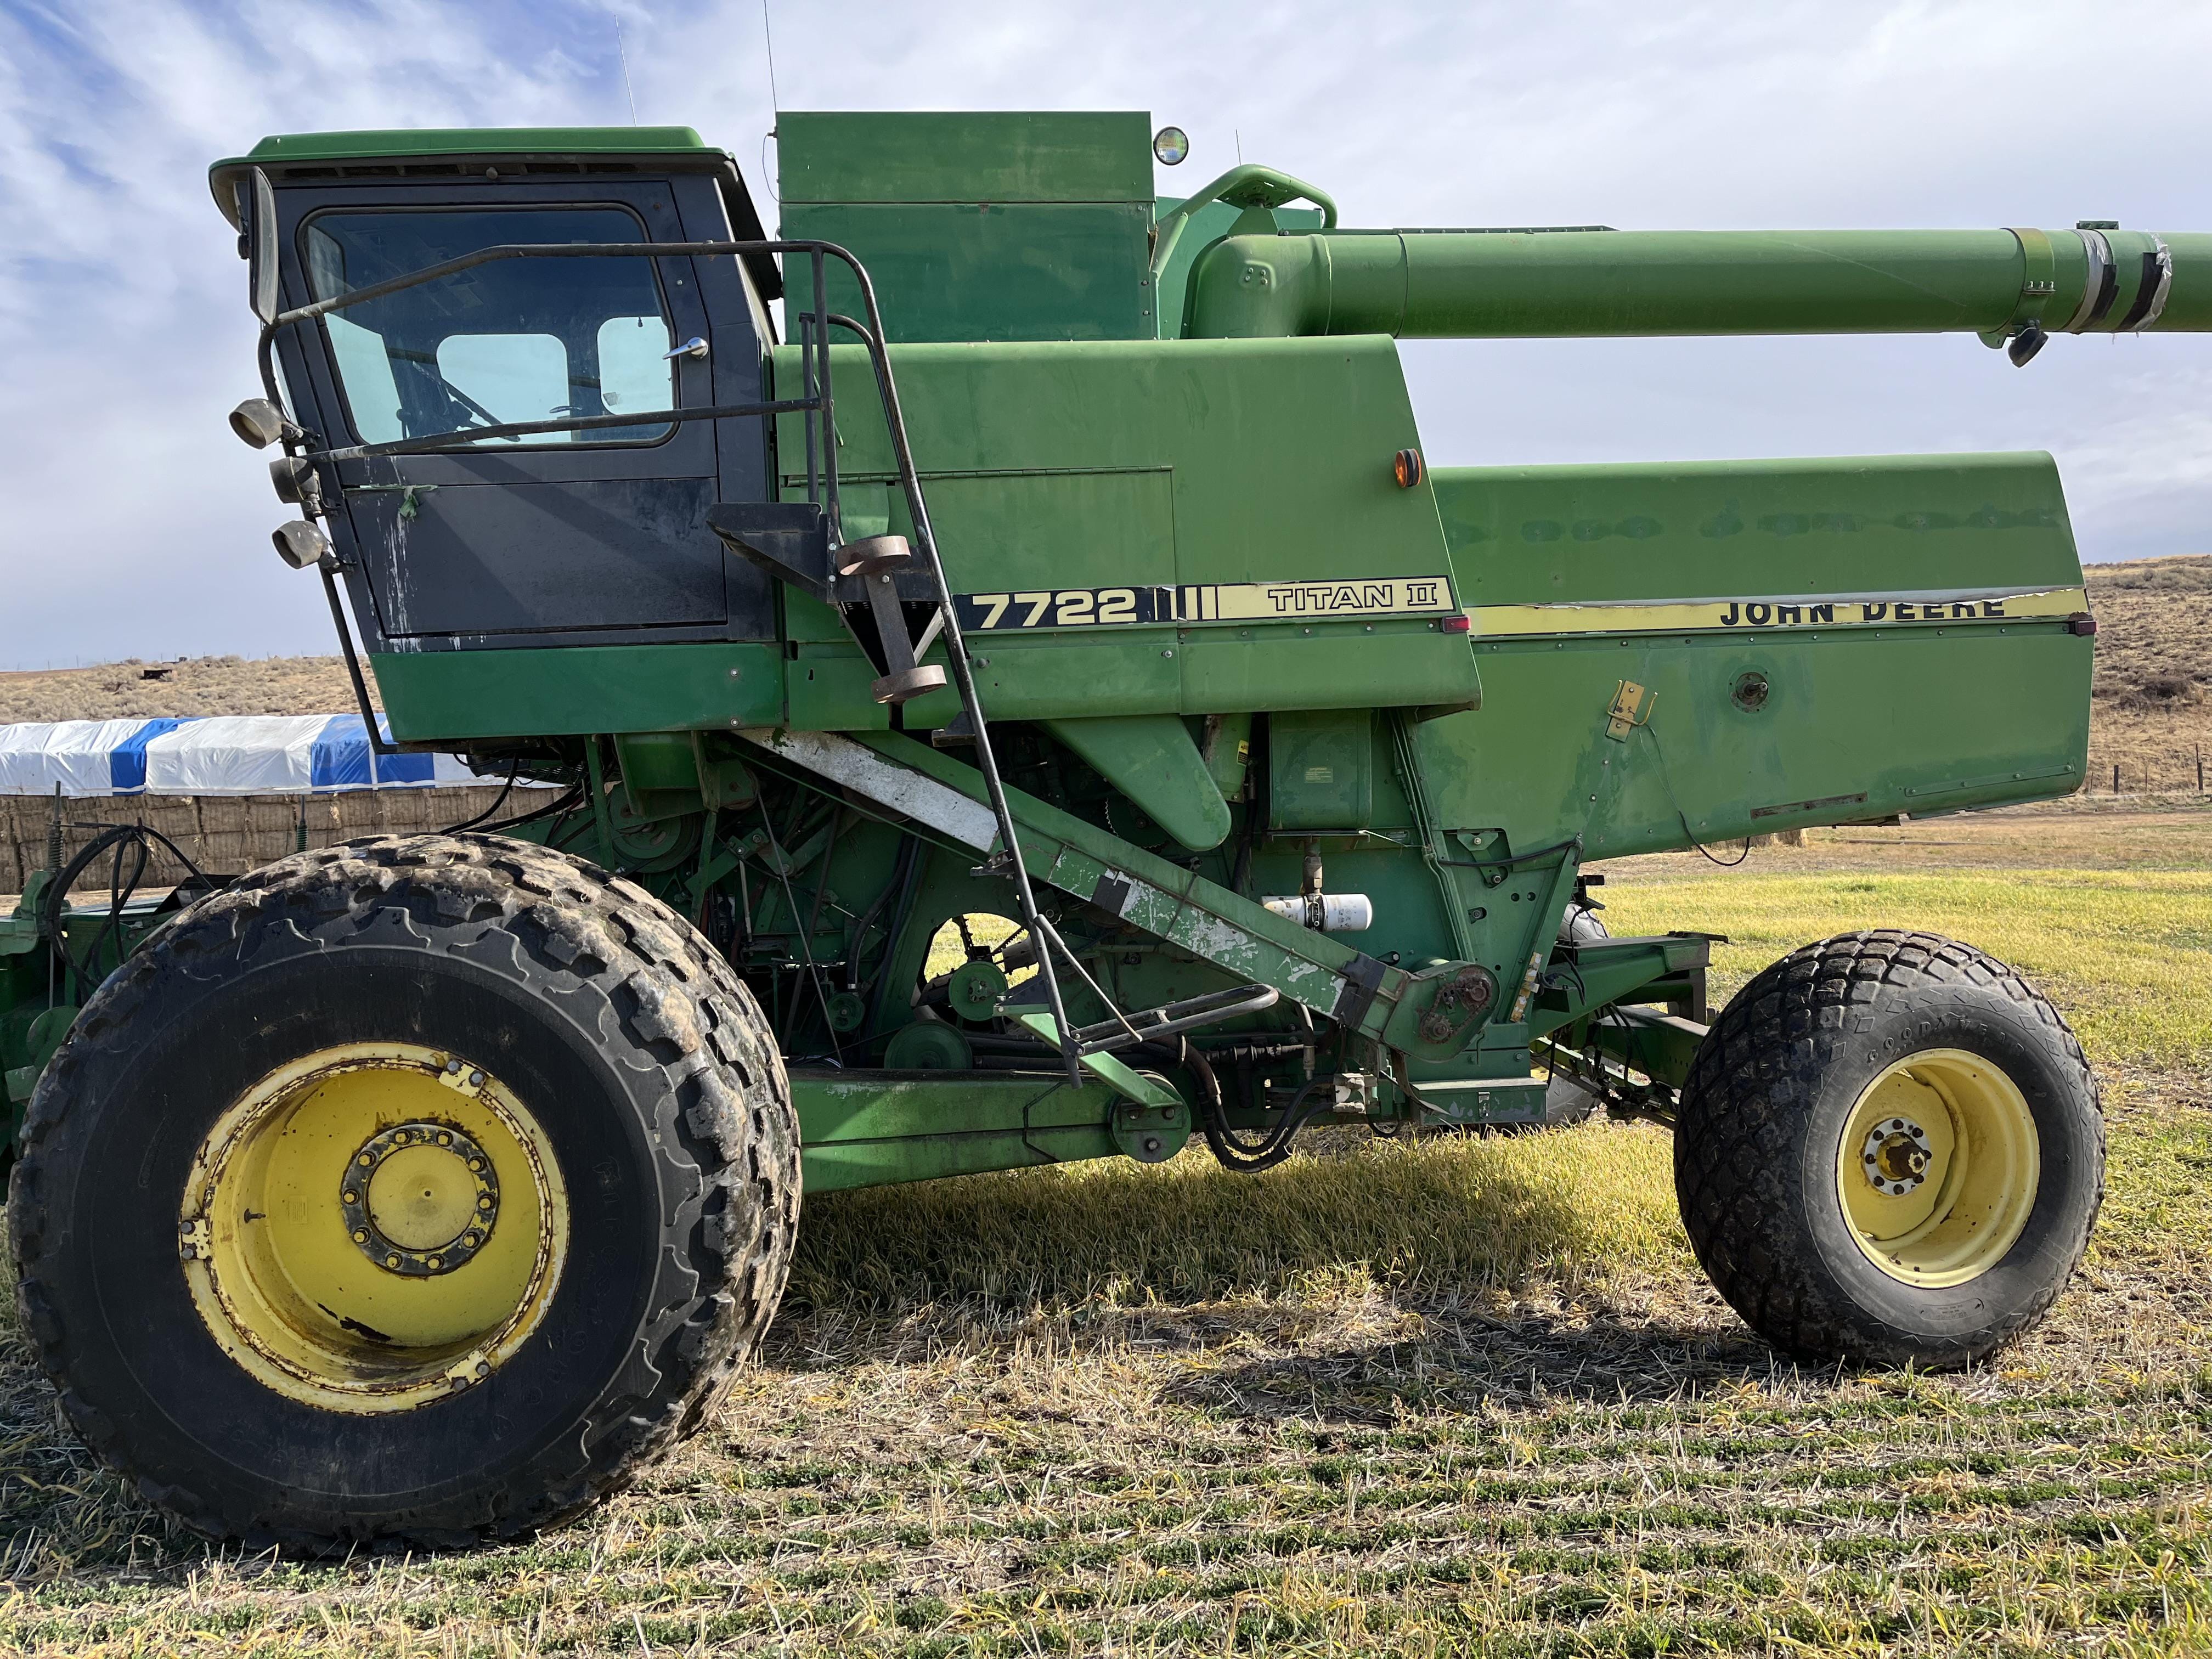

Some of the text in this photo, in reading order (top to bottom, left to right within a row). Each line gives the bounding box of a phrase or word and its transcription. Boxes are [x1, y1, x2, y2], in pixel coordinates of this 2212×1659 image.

[972, 582, 1438, 629] 7722 TITAN II
[1720, 601, 2006, 625] JOHN DEERE
